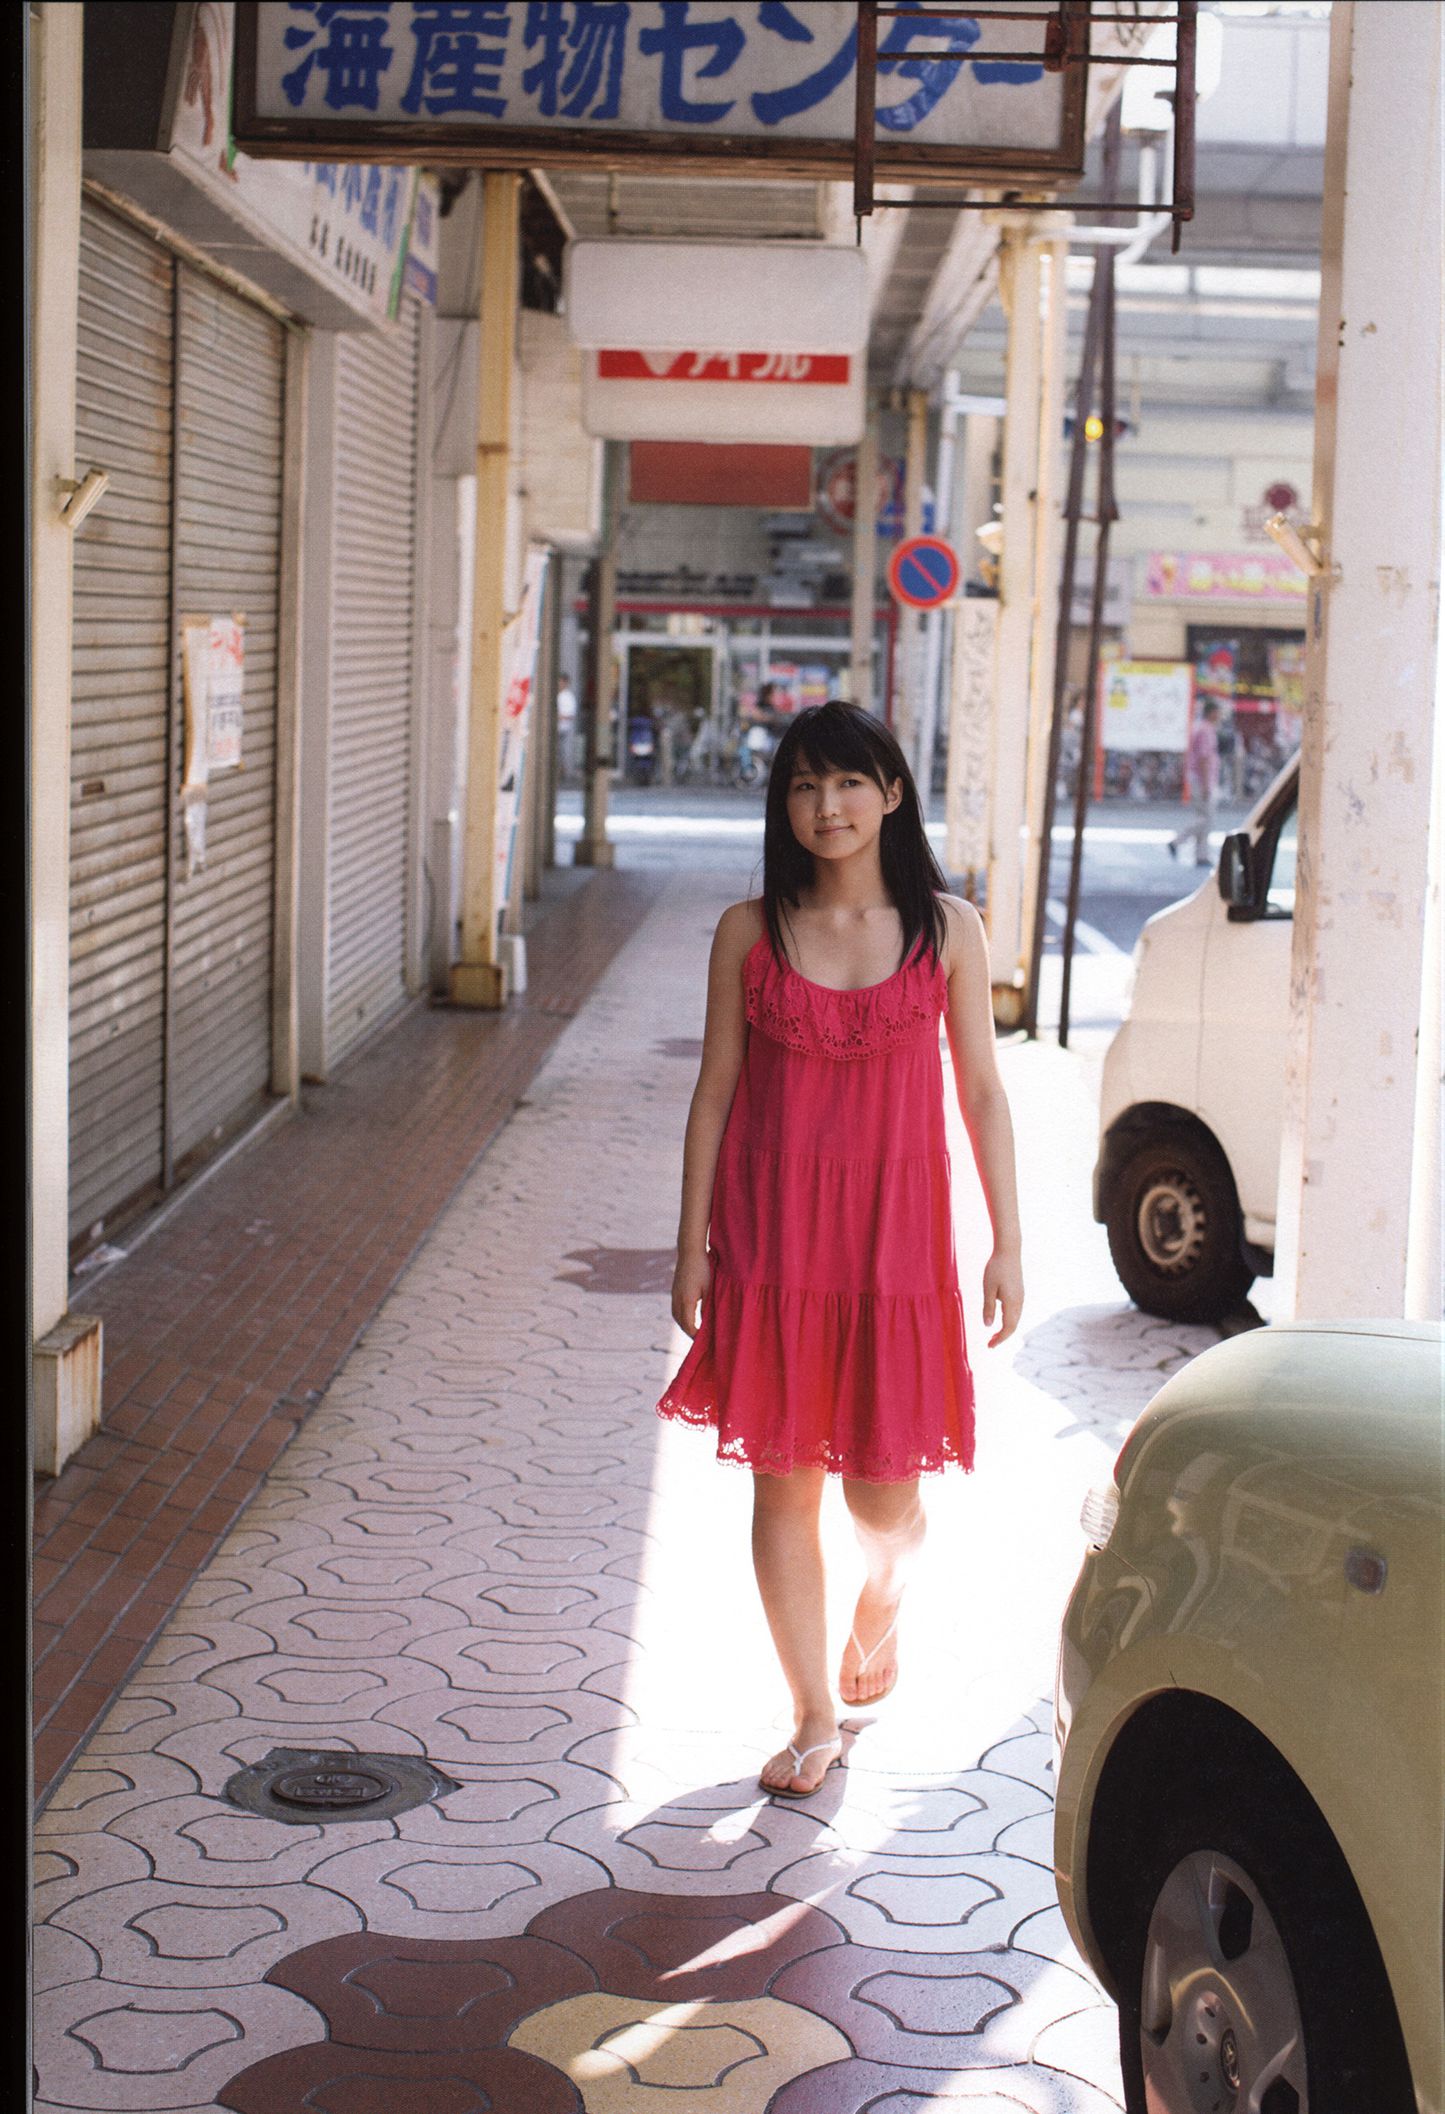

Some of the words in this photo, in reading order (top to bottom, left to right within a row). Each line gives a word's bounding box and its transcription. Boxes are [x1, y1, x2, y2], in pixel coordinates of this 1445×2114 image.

[282, 2, 1044, 131] 海産物センター
